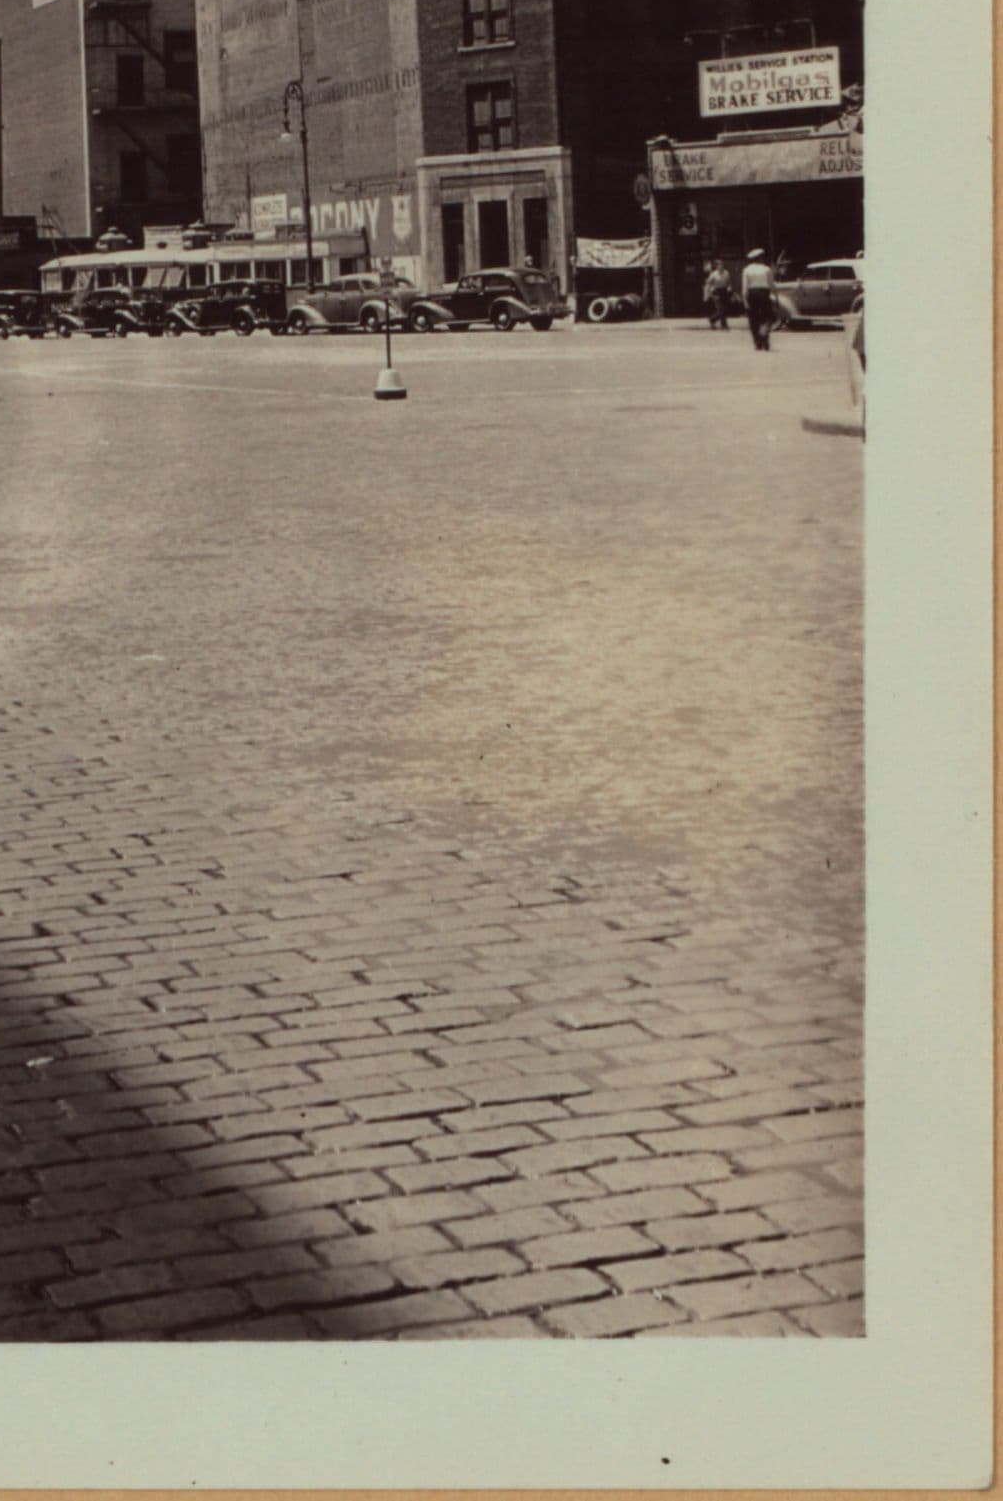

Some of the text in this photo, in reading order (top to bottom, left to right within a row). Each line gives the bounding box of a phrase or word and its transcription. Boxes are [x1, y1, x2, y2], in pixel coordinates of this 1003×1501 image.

[748, 59, 788, 70] SERVICE
[792, 53, 834, 66] STATION
[709, 70, 831, 94] Mobilgas
[708, 86, 834, 110] BRAKE SERVICE
